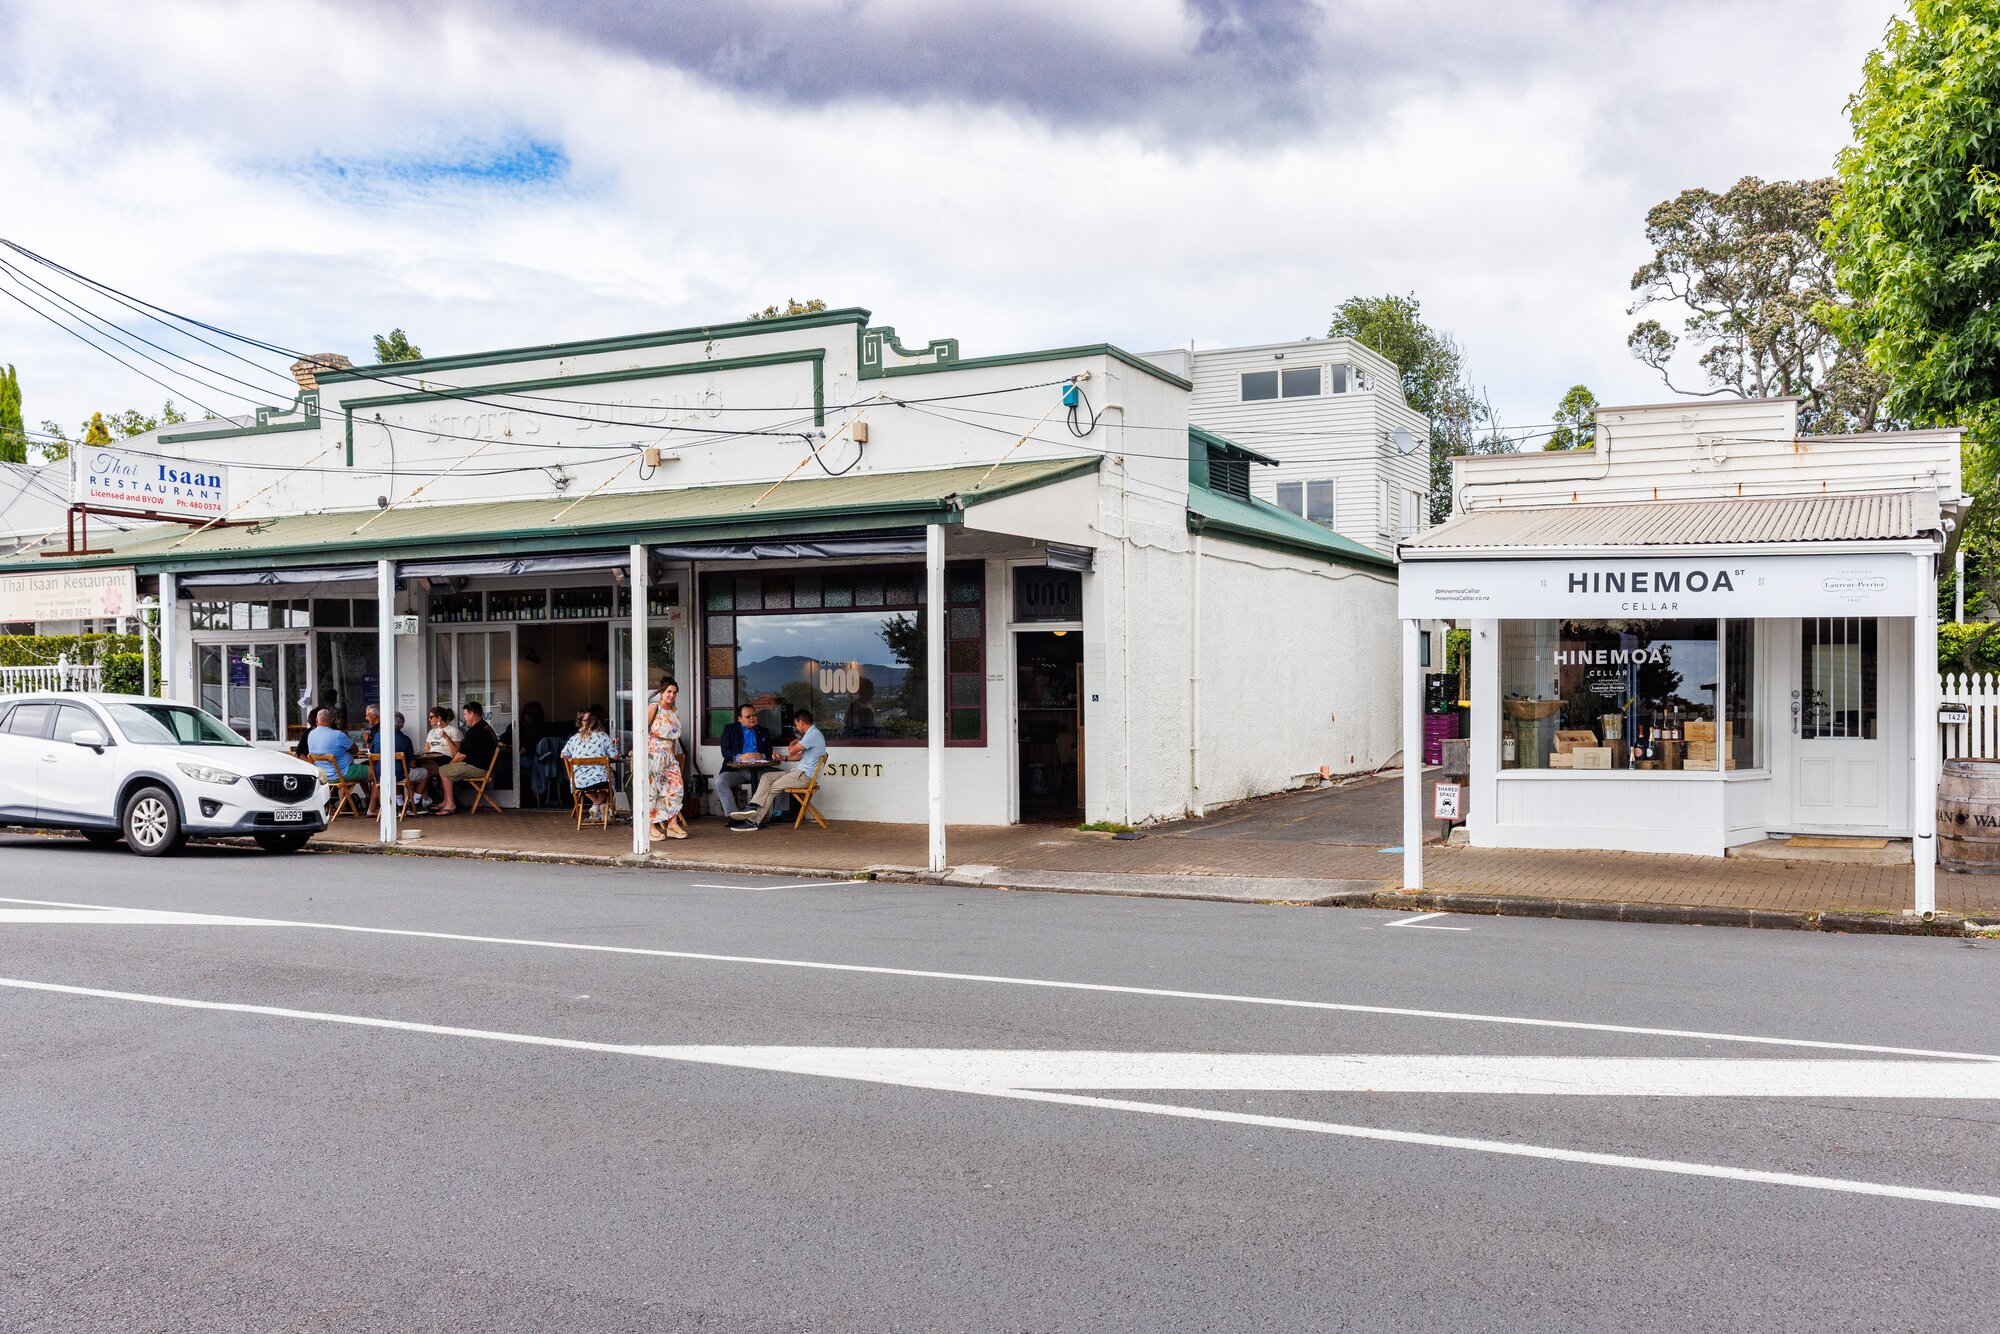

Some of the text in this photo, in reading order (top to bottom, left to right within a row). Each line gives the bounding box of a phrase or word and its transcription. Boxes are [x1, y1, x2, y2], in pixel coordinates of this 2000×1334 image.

[90, 453, 138, 476] Thai
[158, 464, 221, 488] Isaan
[90, 475, 221, 500] RESTAURANT
[90, 489, 221, 511] Licensed and BYOW Ph: 480 0574
[2, 573, 126, 593] Thai Isaan Restaurant
[1568, 570, 1734, 593] HINEMOA
[49, 608, 59, 618] 09
[75, 607, 92, 617] 0574
[1621, 602, 1678, 611] CELLAR
[1553, 648, 1664, 665] HINEMOA
